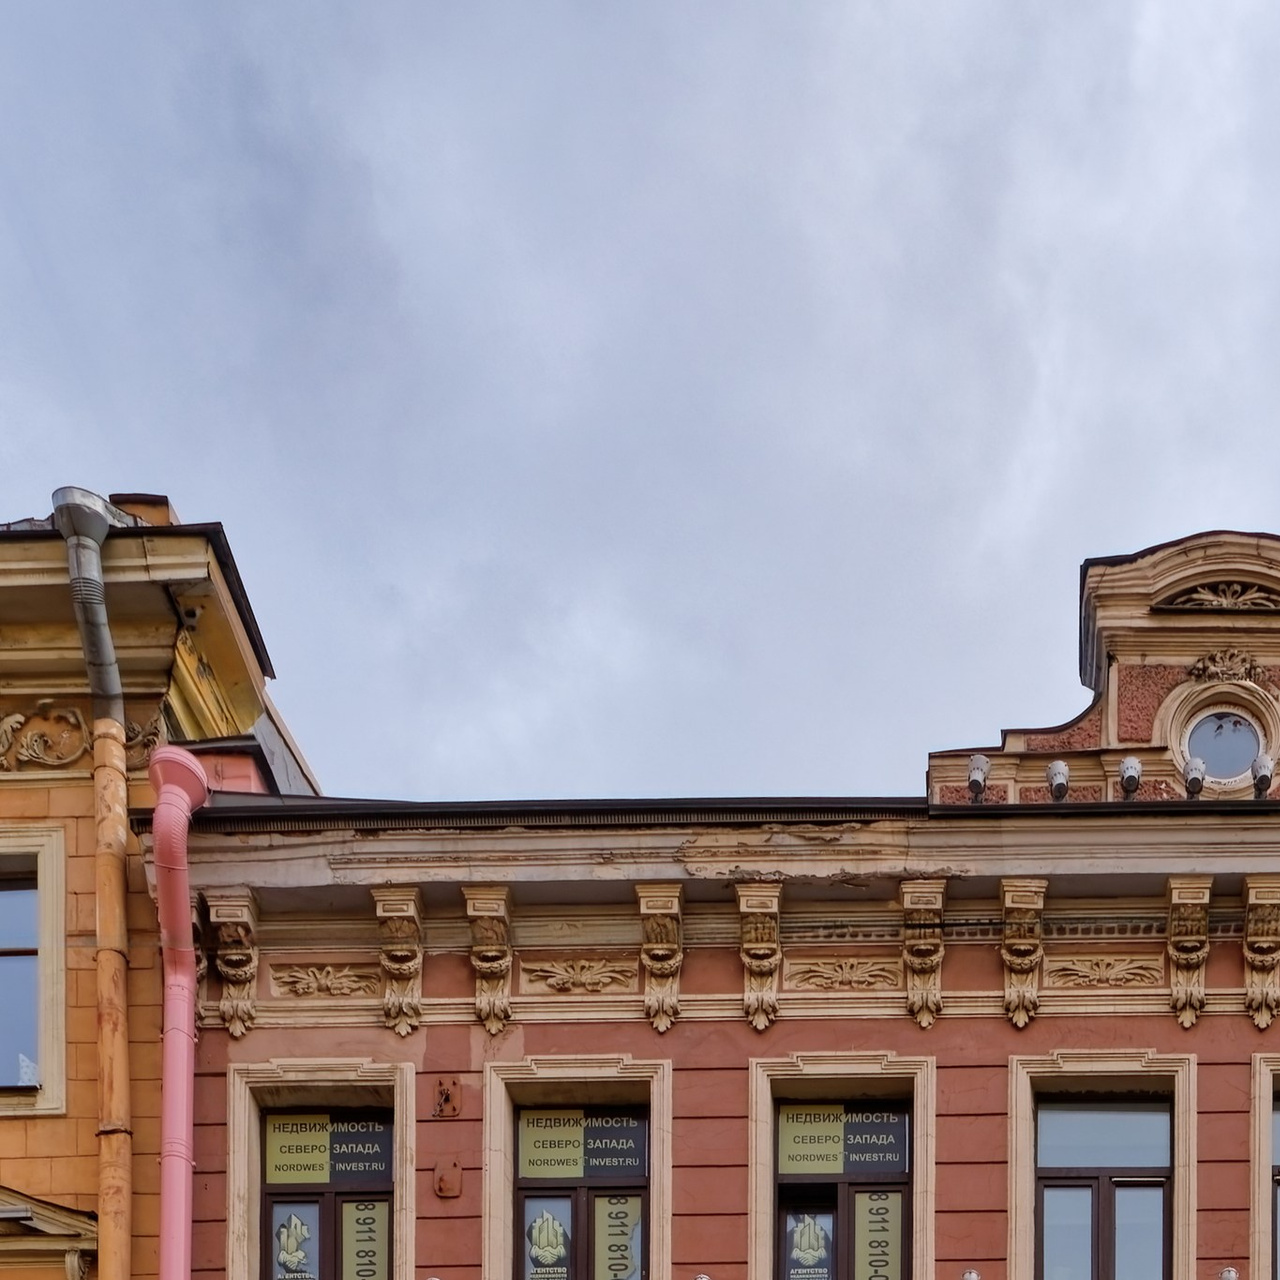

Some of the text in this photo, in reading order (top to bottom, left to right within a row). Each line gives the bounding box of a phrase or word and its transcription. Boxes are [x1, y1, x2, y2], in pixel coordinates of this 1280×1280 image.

[526, 1116, 638, 1129] НЕДВИЖИМОСТЬ
[786, 1112, 899, 1124] НЕДВИЖИМОСТЬ
[272, 1121, 384, 1134] НЕДВИЖИМОСТЬ
[607, 1196, 629, 1206] 8
[868, 1192, 889, 1202] 8
[355, 1202, 376, 1212] 8
[607, 1211, 629, 1236] 911
[868, 1207, 890, 1233] 911
[355, 1217, 377, 1243] 911
